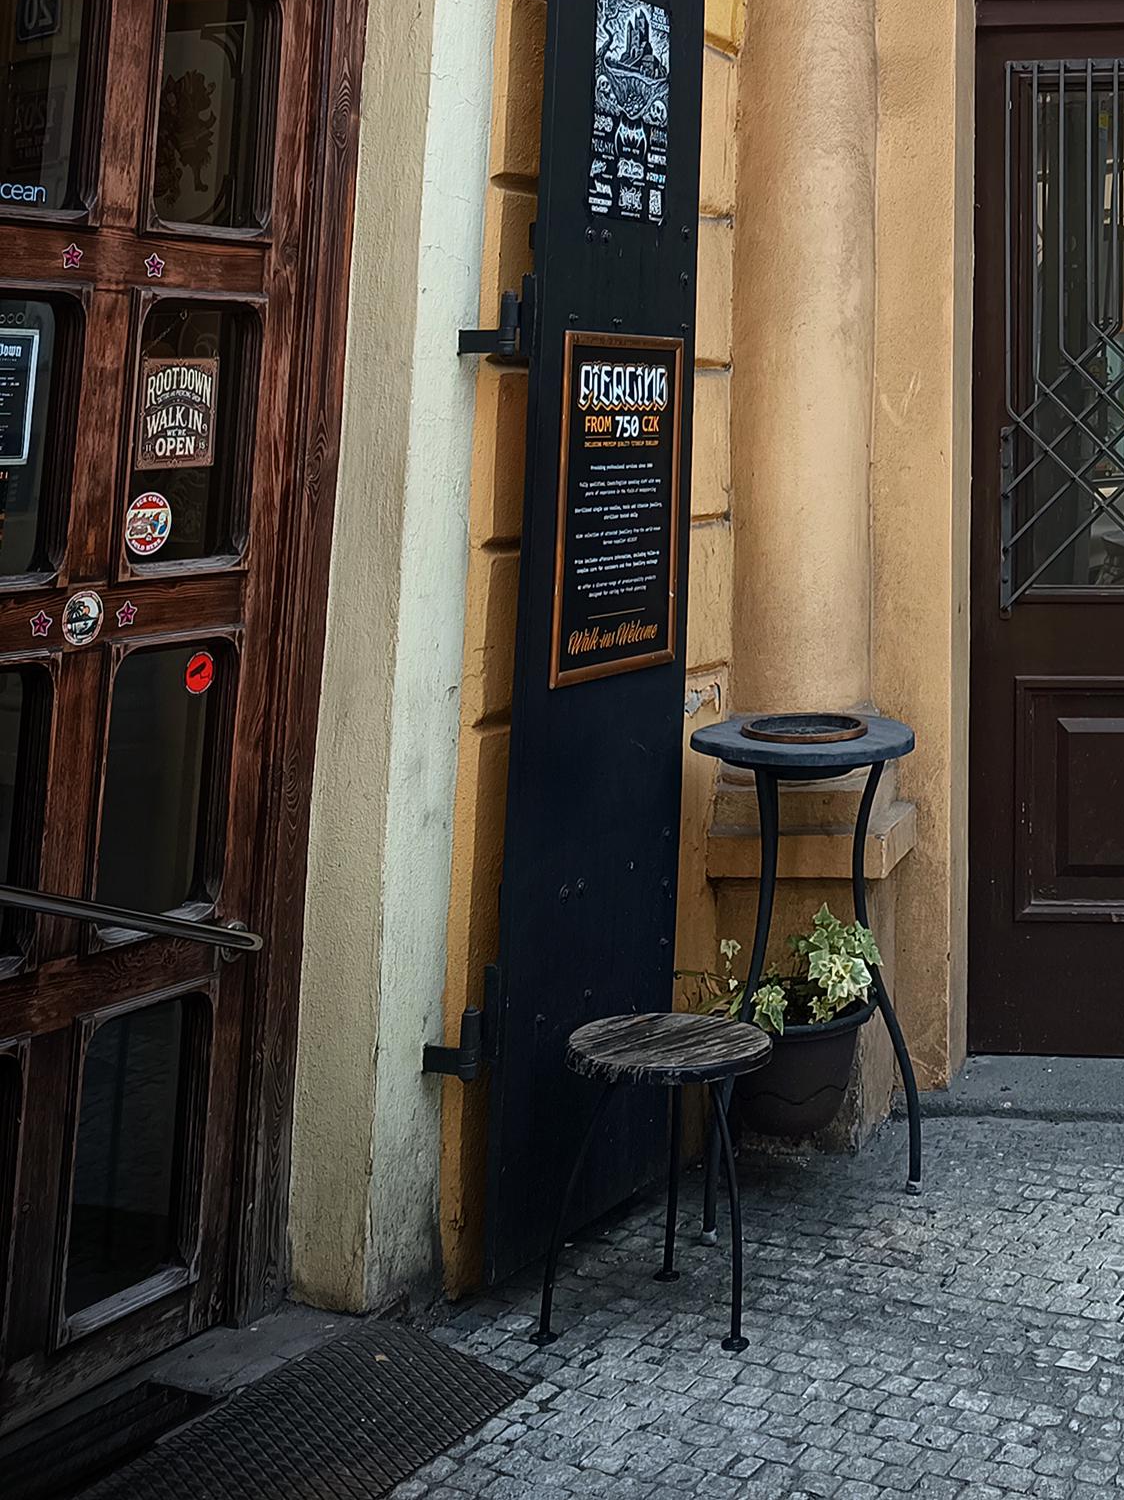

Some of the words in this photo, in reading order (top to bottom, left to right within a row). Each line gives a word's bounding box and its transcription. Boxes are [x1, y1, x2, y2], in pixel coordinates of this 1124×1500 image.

[0, 182, 46, 203] cean
[146, 405, 188, 439] WALK
[585, 415, 612, 433] FROM
[615, 415, 640, 438] 750
[641, 415, 660, 432] CZK
[155, 436, 196, 457] OPEN
[615, 619, 658, 646] Welcome
